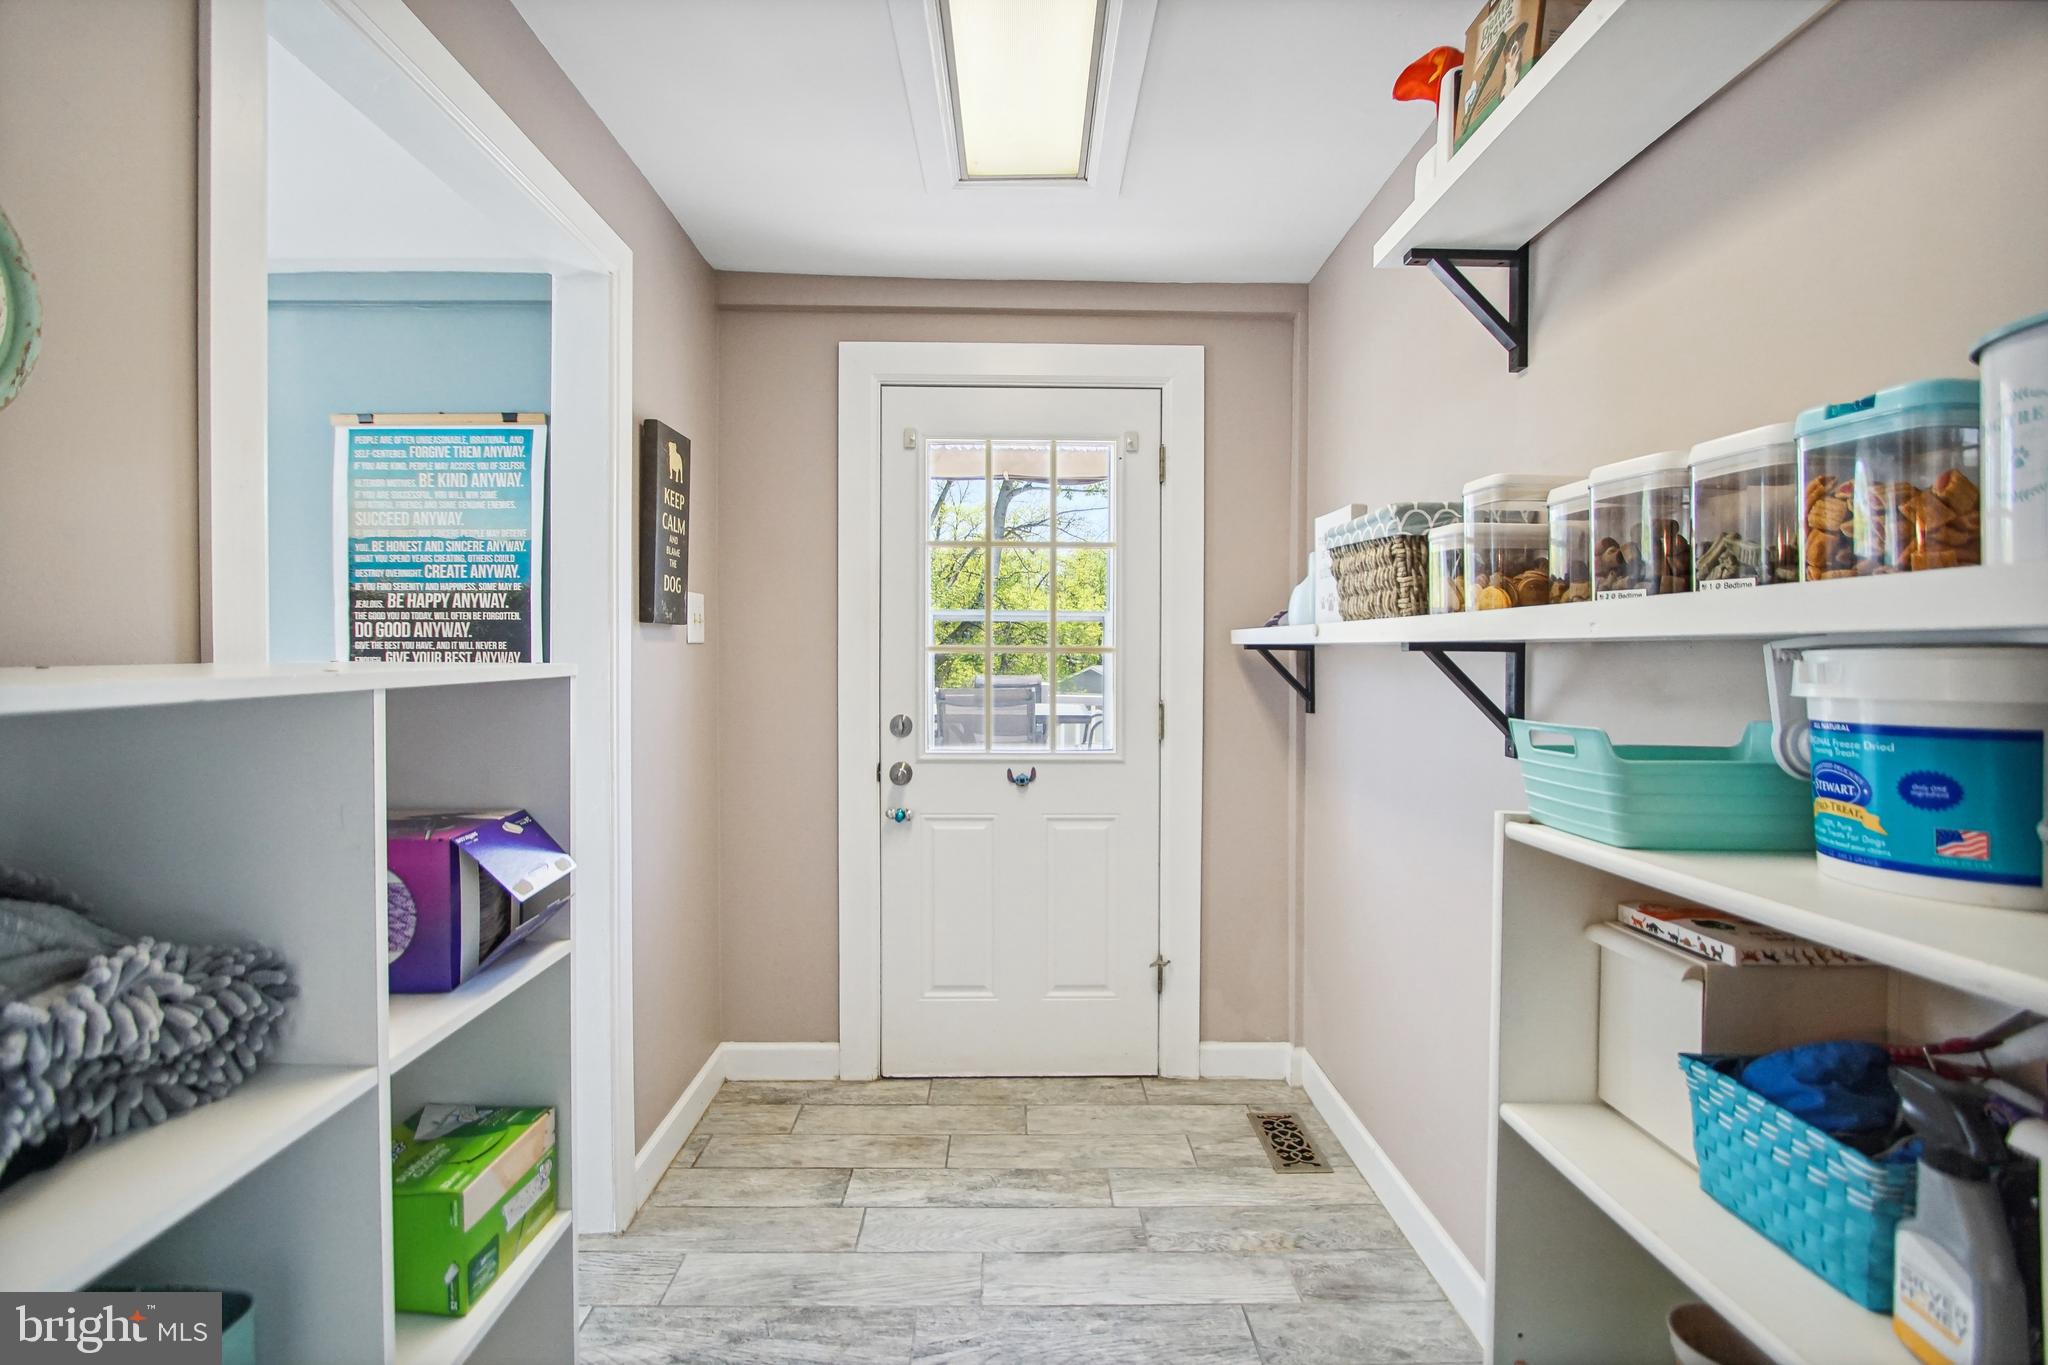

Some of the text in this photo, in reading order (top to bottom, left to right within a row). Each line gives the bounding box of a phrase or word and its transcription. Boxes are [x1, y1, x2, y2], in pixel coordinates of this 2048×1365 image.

[409, 445, 450, 458] FORGIVE
[452, 445, 481, 458] THEM
[483, 445, 526, 458] ANYWAY.
[419, 472, 435, 488] BE
[438, 472, 468, 488] KIND
[471, 472, 524, 488] ANYWAY.
[664, 487, 685, 510] KEEP
[355, 511, 464, 526] SUCCEED ANYWAY.
[662, 512, 686, 536] CALM
[669, 534, 679, 545] AND
[372, 541, 385, 552] BE
[386, 541, 423, 552] HONEST
[425, 541, 444, 552] AND
[445, 541, 484, 552] SINCERE
[487, 541, 526, 552] ANYWAY.
[666, 545, 681, 558] BLAME
[388, 554, 411, 562] SPEND
[412, 554, 433, 562] YEARS
[468, 554, 493, 562] OTHERS
[494, 554, 515, 562] COULD
[669, 558, 677, 569] THE
[424, 564, 468, 578] CREATE
[470, 564, 520, 578] ANYWAY.
[392, 582, 424, 591] SERENITY
[425, 582, 439, 591] AND
[479, 582, 497, 591] SOME
[498, 582, 512, 591] MAY
[513, 582, 522, 591] BE
[663, 574, 682, 594] DOG
[387, 593, 404, 608] BE
[407, 593, 450, 608] HAPPY
[452, 593, 509, 608] ANYWAY.
[355, 612, 368, 620] THE
[368, 612, 385, 620] GOOD
[387, 612, 399, 620] YOU
[401, 612, 410, 620] DO
[434, 612, 450, 620] WILL
[451, 612, 471, 620] OFTEN
[473, 612, 482, 620] BE
[483, 612, 521, 620] FORGOTTEN.
[355, 622, 472, 637] DO GOOD ANYWAY.
[355, 641, 370, 650] GIVE
[371, 641, 384, 650] THE
[385, 641, 400, 650] BEST
[401, 641, 414, 650] YOU
[436, 641, 450, 650] AND
[451, 641, 457, 650] IT
[459, 641, 474, 650] WILL
[475, 641, 497, 650] NEVER
[498, 641, 507, 650] BE
[386, 651, 409, 662] GIVE
[412, 651, 442, 662] YOUR
[445, 651, 472, 662] BEST
[1821, 722, 1850, 732] NATURAL
[1863, 740, 1895, 752] Dried
[1816, 780, 1856, 796] STEWART
